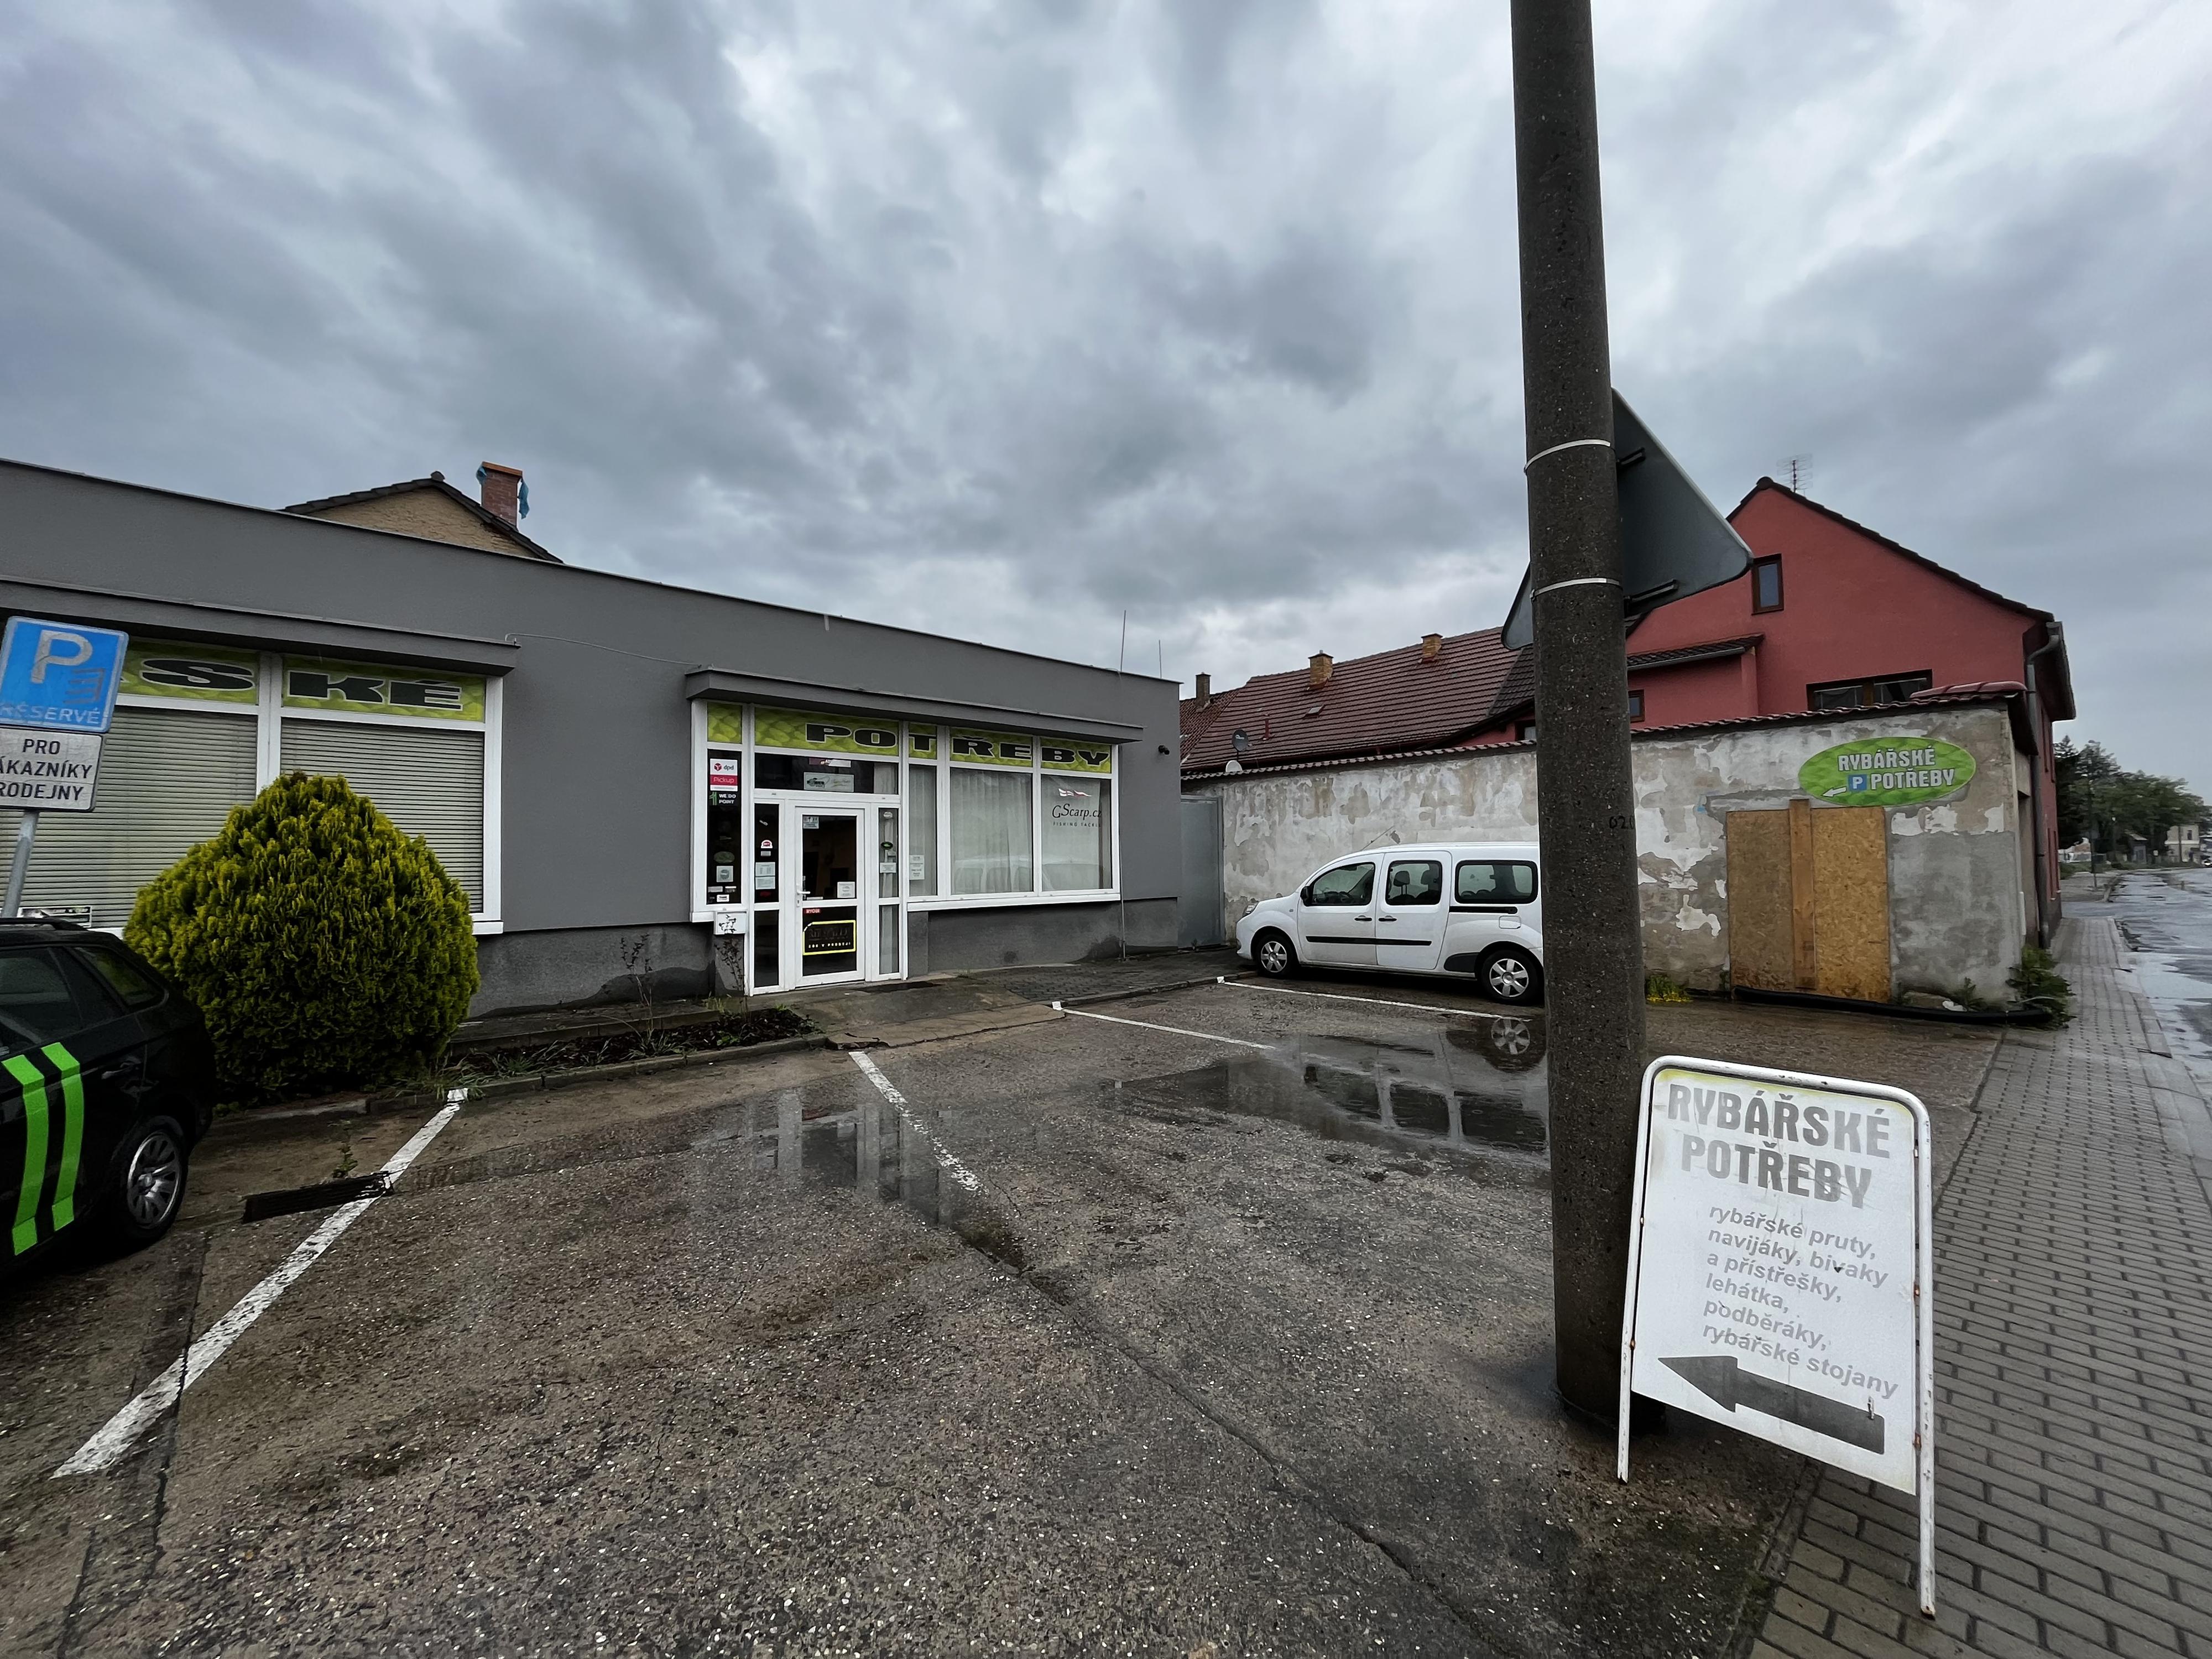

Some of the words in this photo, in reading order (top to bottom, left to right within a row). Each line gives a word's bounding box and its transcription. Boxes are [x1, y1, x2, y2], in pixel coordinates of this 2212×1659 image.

[31, 629, 93, 684] P
[121, 658, 463, 711] SKÉ
[22, 738, 61, 755] PRO
[806, 723, 1109, 766] POTŘEBY
[1838, 745, 1936, 771] RYBÁŘSKÉ
[1870, 768, 1955, 790] POTŘEBY
[1667, 1084, 1890, 1159] RYBÁŘSKÉ
[1681, 1134, 1872, 1209] POTŘEBY
[1708, 1229, 1801, 1266] navijáky,
[1810, 1251, 1889, 1288] bivaky
[1709, 1207, 1803, 1238] rybářské
[1809, 1230, 1876, 1260] pruty,
[1705, 1273, 1789, 1313] lehátka,
[1707, 1253, 1719, 1266] a
[1724, 1257, 1841, 1303] přístřešky,
[1703, 1300, 1827, 1351] podběráky,
[1703, 1324, 1800, 1365] rybářské
[1806, 1357, 1899, 1400] stojany
